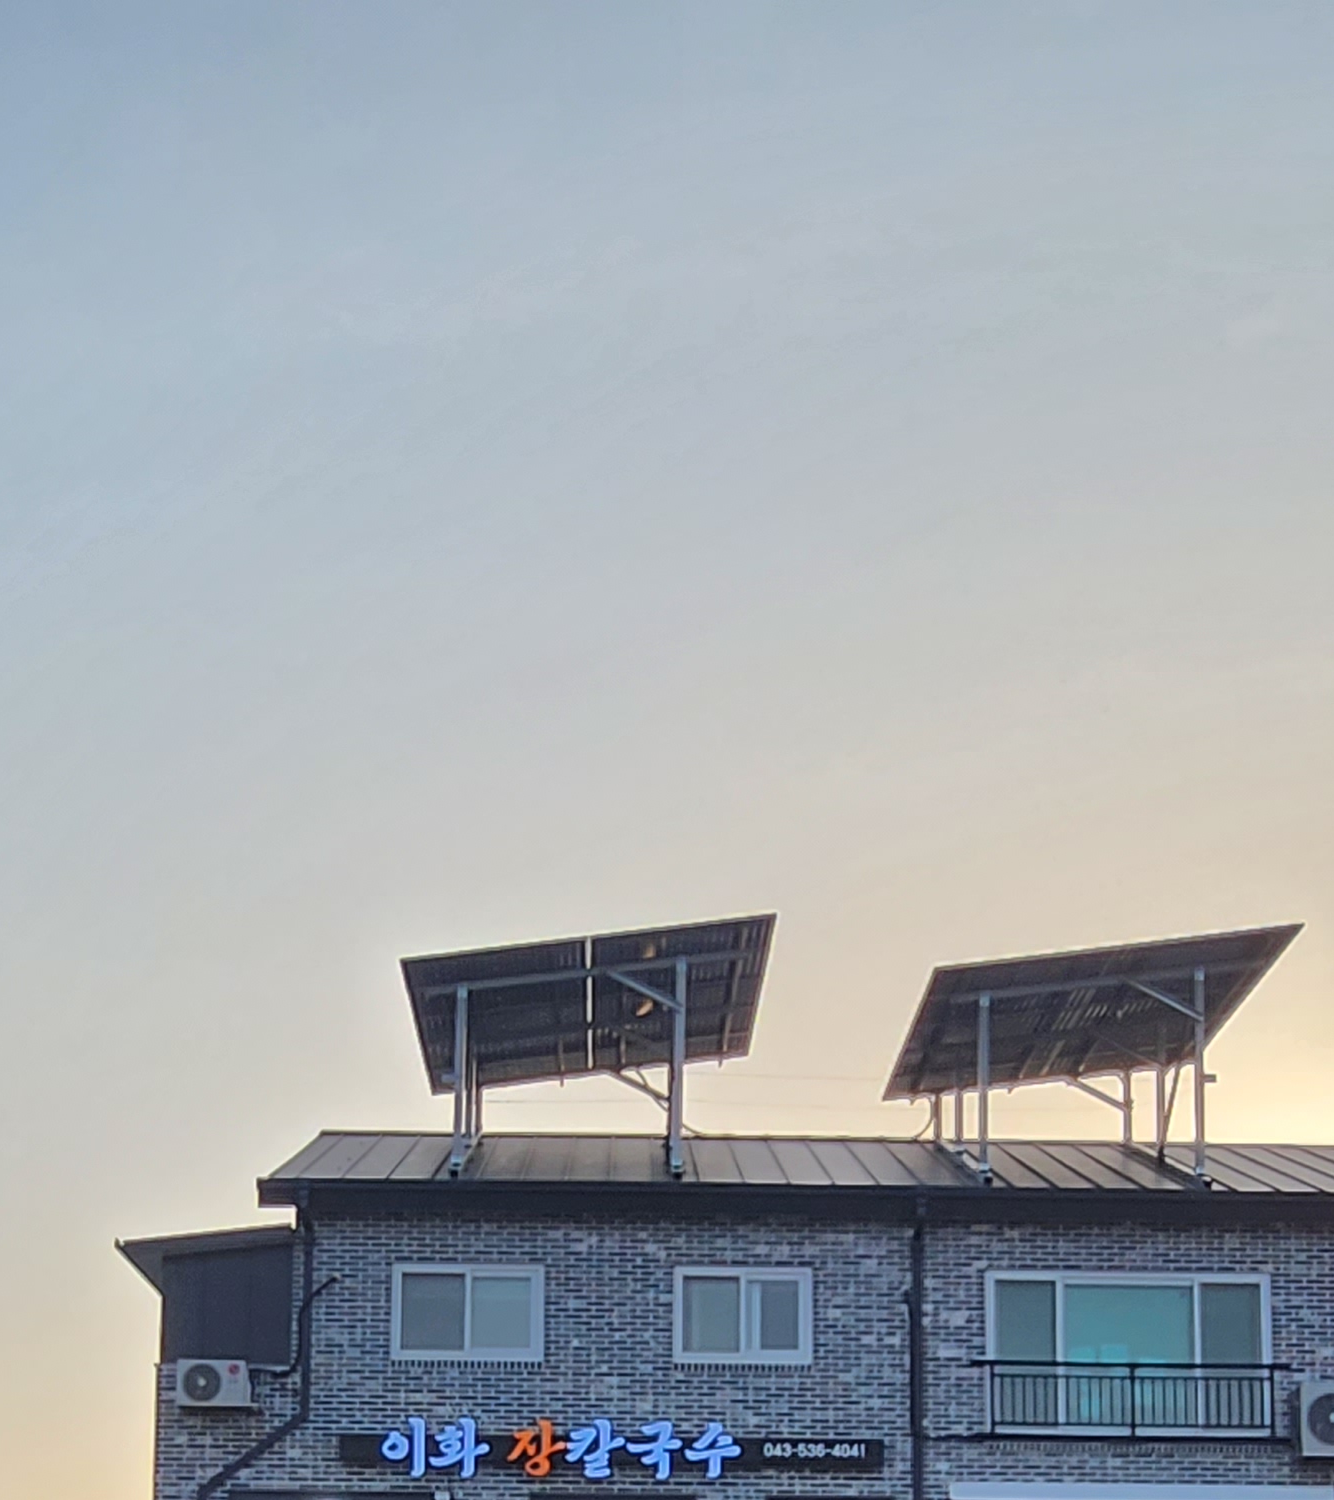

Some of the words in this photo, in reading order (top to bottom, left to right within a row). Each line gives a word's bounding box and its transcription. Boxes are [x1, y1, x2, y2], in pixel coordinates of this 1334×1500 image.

[380, 1416, 491, 1479] 이화
[506, 1417, 742, 1480] 장칼국수
[763, 1442, 866, 1458] 043-536-4041
